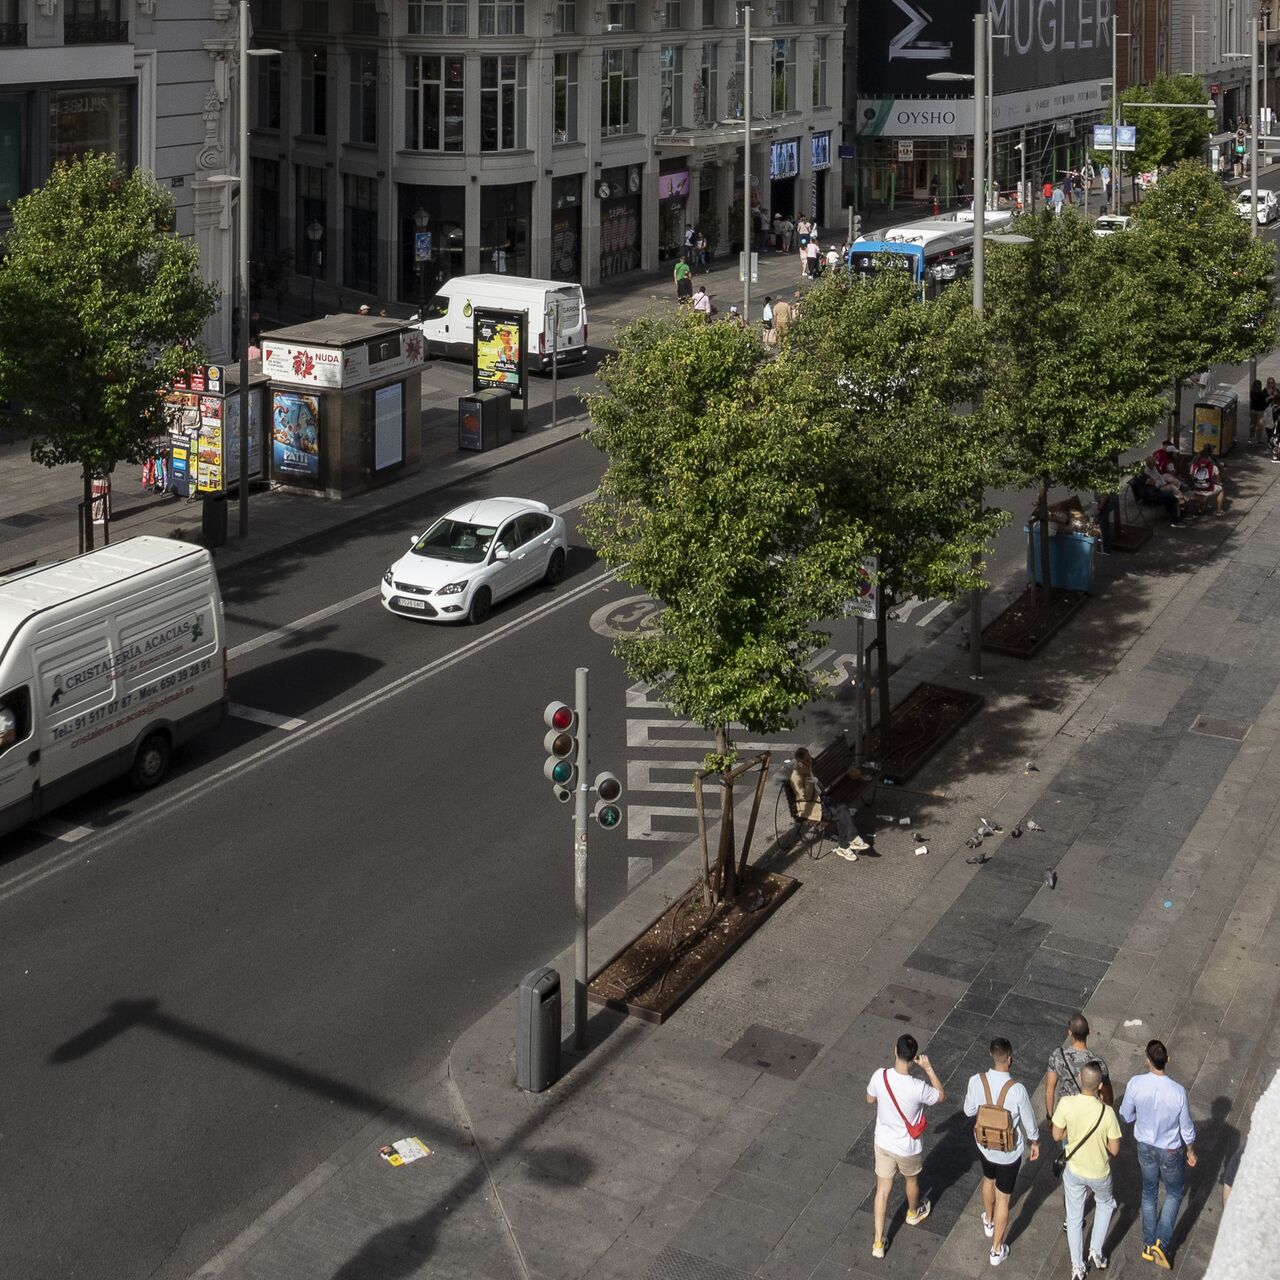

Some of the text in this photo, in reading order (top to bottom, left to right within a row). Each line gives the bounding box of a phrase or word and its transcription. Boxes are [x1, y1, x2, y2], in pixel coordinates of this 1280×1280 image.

[897, 111, 955, 125] OYSHO
[315, 353, 339, 363] NUDA
[66, 622, 192, 690] CRISTALERÍA ACACIAS
[75, 718, 86, 730] 91
[89, 707, 105, 723] 517
[107, 702, 119, 714] 07
[122, 695, 132, 709] 87
[160, 676, 176, 690] 650
[177, 671, 188, 682] 39
[189, 665, 200, 677] 28
[201, 659, 212, 671] 91
